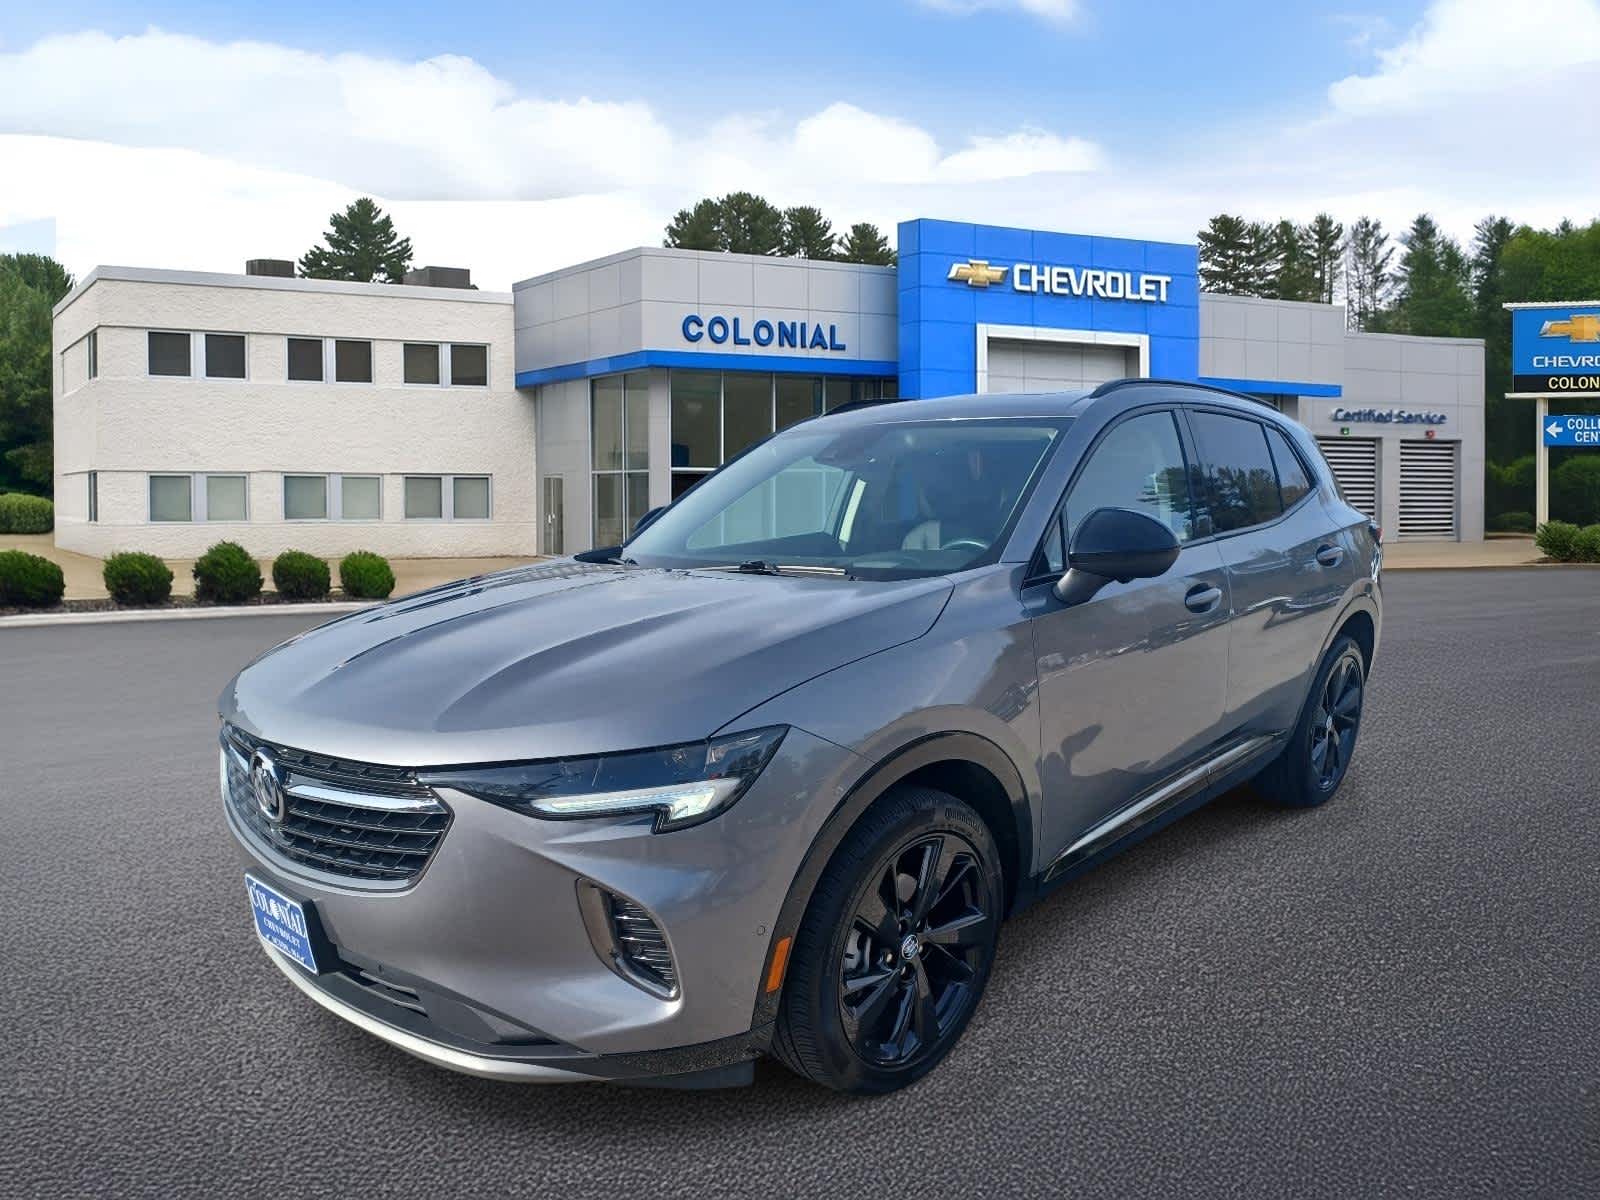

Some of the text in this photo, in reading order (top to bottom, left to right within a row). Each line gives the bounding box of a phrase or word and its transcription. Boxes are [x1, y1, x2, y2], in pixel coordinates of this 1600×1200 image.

[1013, 263, 1171, 303] CHEVROLET
[682, 314, 846, 351] COLONIAL
[1332, 408, 1447, 425] Certified Service
[1575, 431, 1600, 443] CEN
